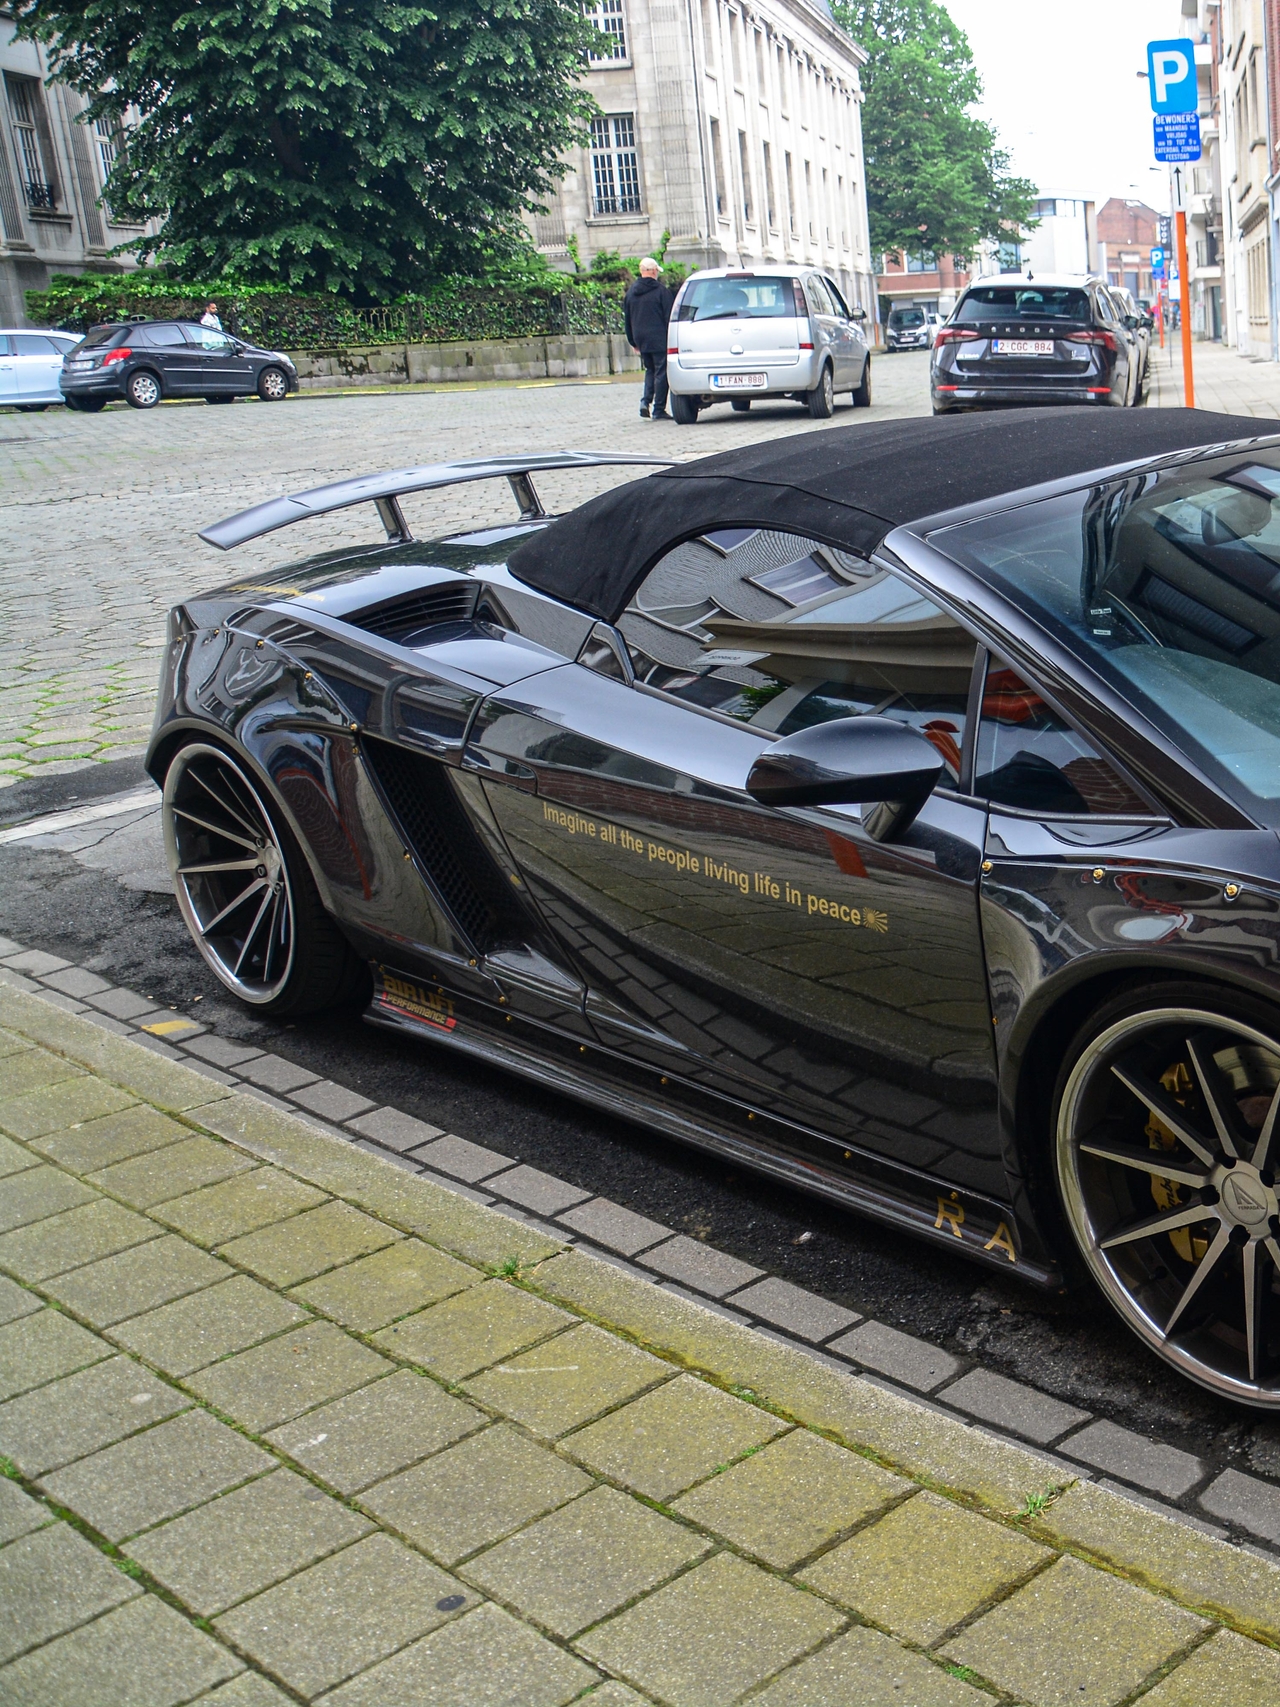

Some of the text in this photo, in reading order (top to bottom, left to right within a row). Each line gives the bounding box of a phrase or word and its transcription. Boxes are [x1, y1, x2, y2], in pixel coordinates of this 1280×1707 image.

[1152, 51, 1189, 102] P
[1155, 114, 1196, 124] BEWONERS
[1166, 131, 1187, 139] VRIJDAG
[1176, 138, 1185, 146] TOT
[1151, 251, 1162, 265] P
[543, 801, 861, 926] Imagine all the people living life in peace
